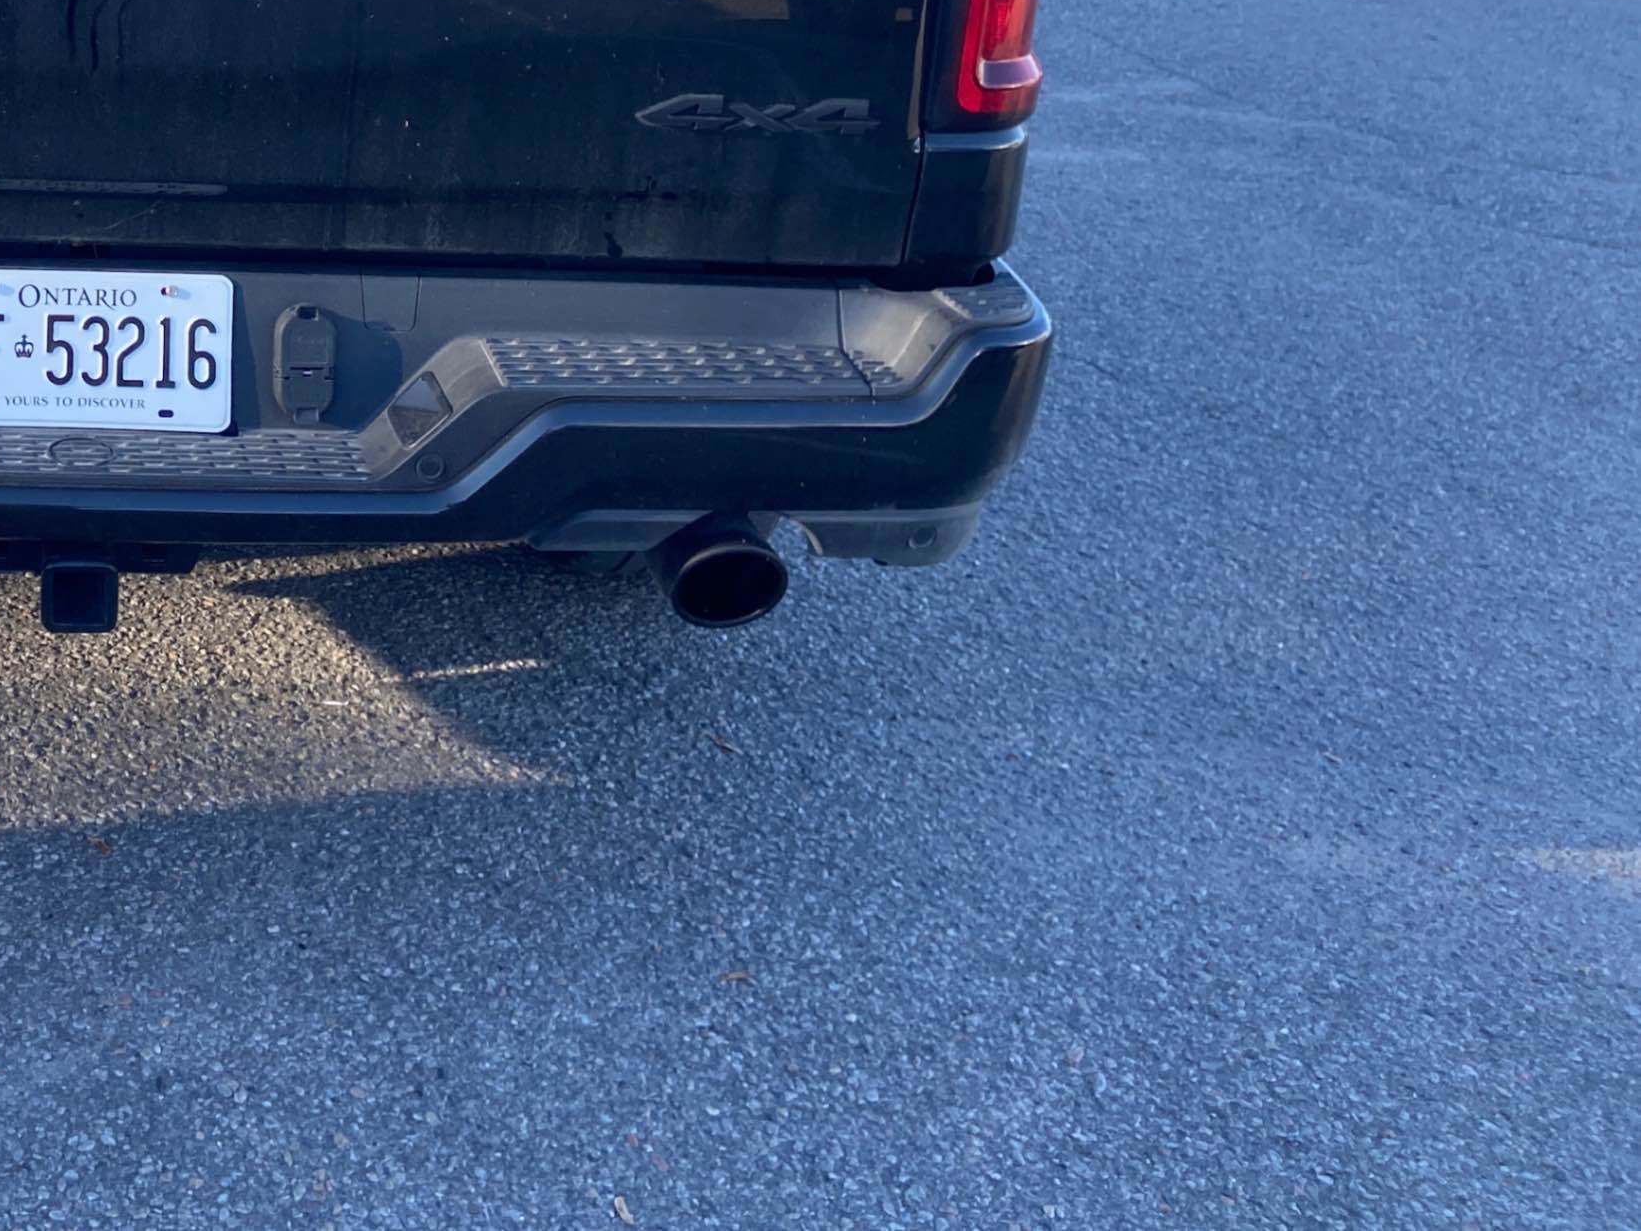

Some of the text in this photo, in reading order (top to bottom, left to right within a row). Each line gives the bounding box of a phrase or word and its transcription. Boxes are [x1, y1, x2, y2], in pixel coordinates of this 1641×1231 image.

[18, 283, 138, 311] ONTARIO
[45, 313, 218, 391] 53216
[4, 395, 146, 410] YOURS TO DISCOVER
